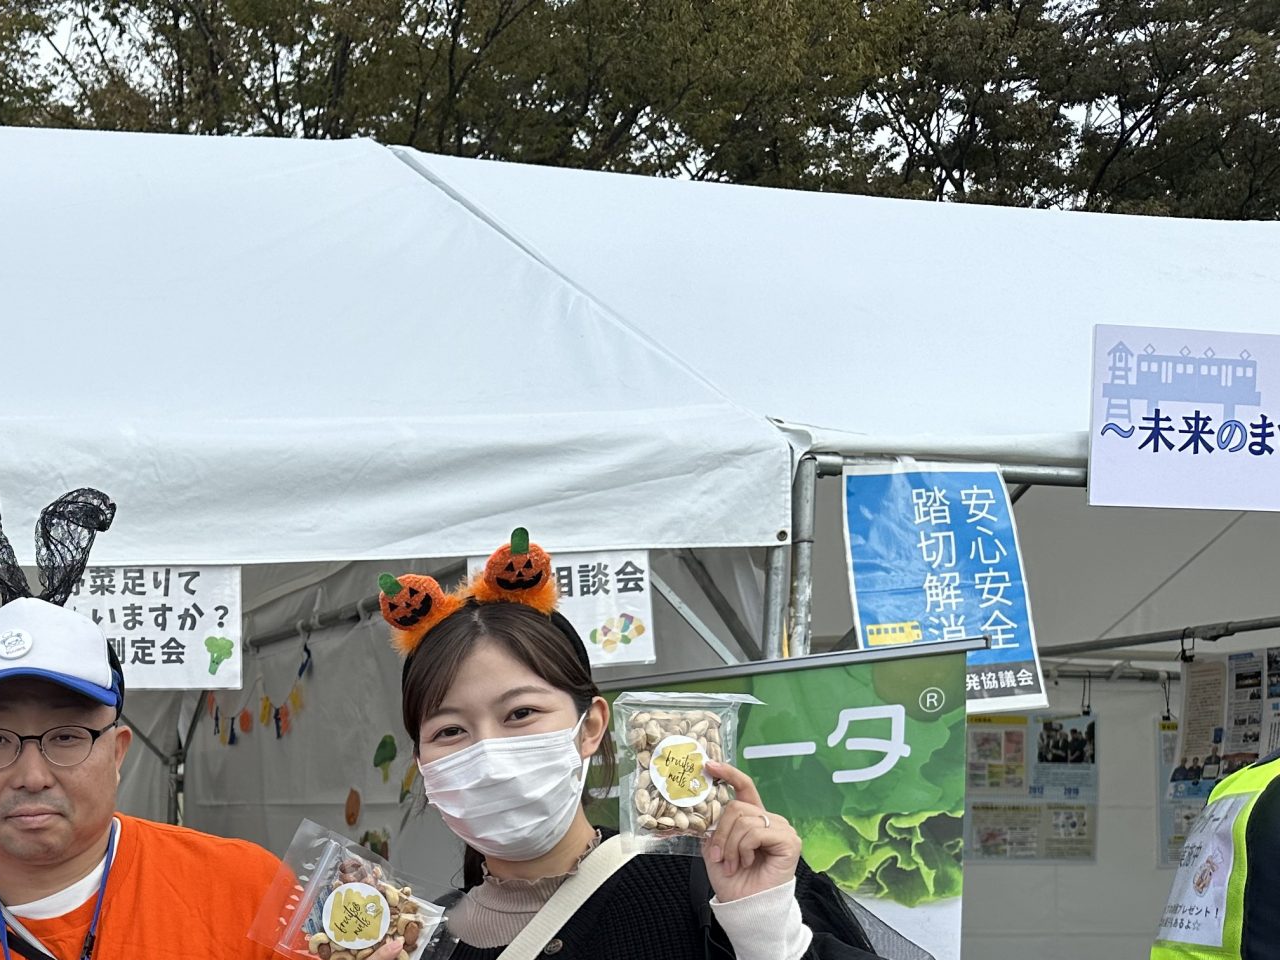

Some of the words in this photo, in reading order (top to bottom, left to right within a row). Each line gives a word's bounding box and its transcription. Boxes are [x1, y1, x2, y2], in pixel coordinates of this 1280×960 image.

[1101, 408, 1280, 456] ～未来のま
[912, 486, 966, 642] 踏切解消
[960, 485, 1020, 649] 安心安全
[668, 770, 687, 788] nuts
[354, 917, 371, 936] nuts
